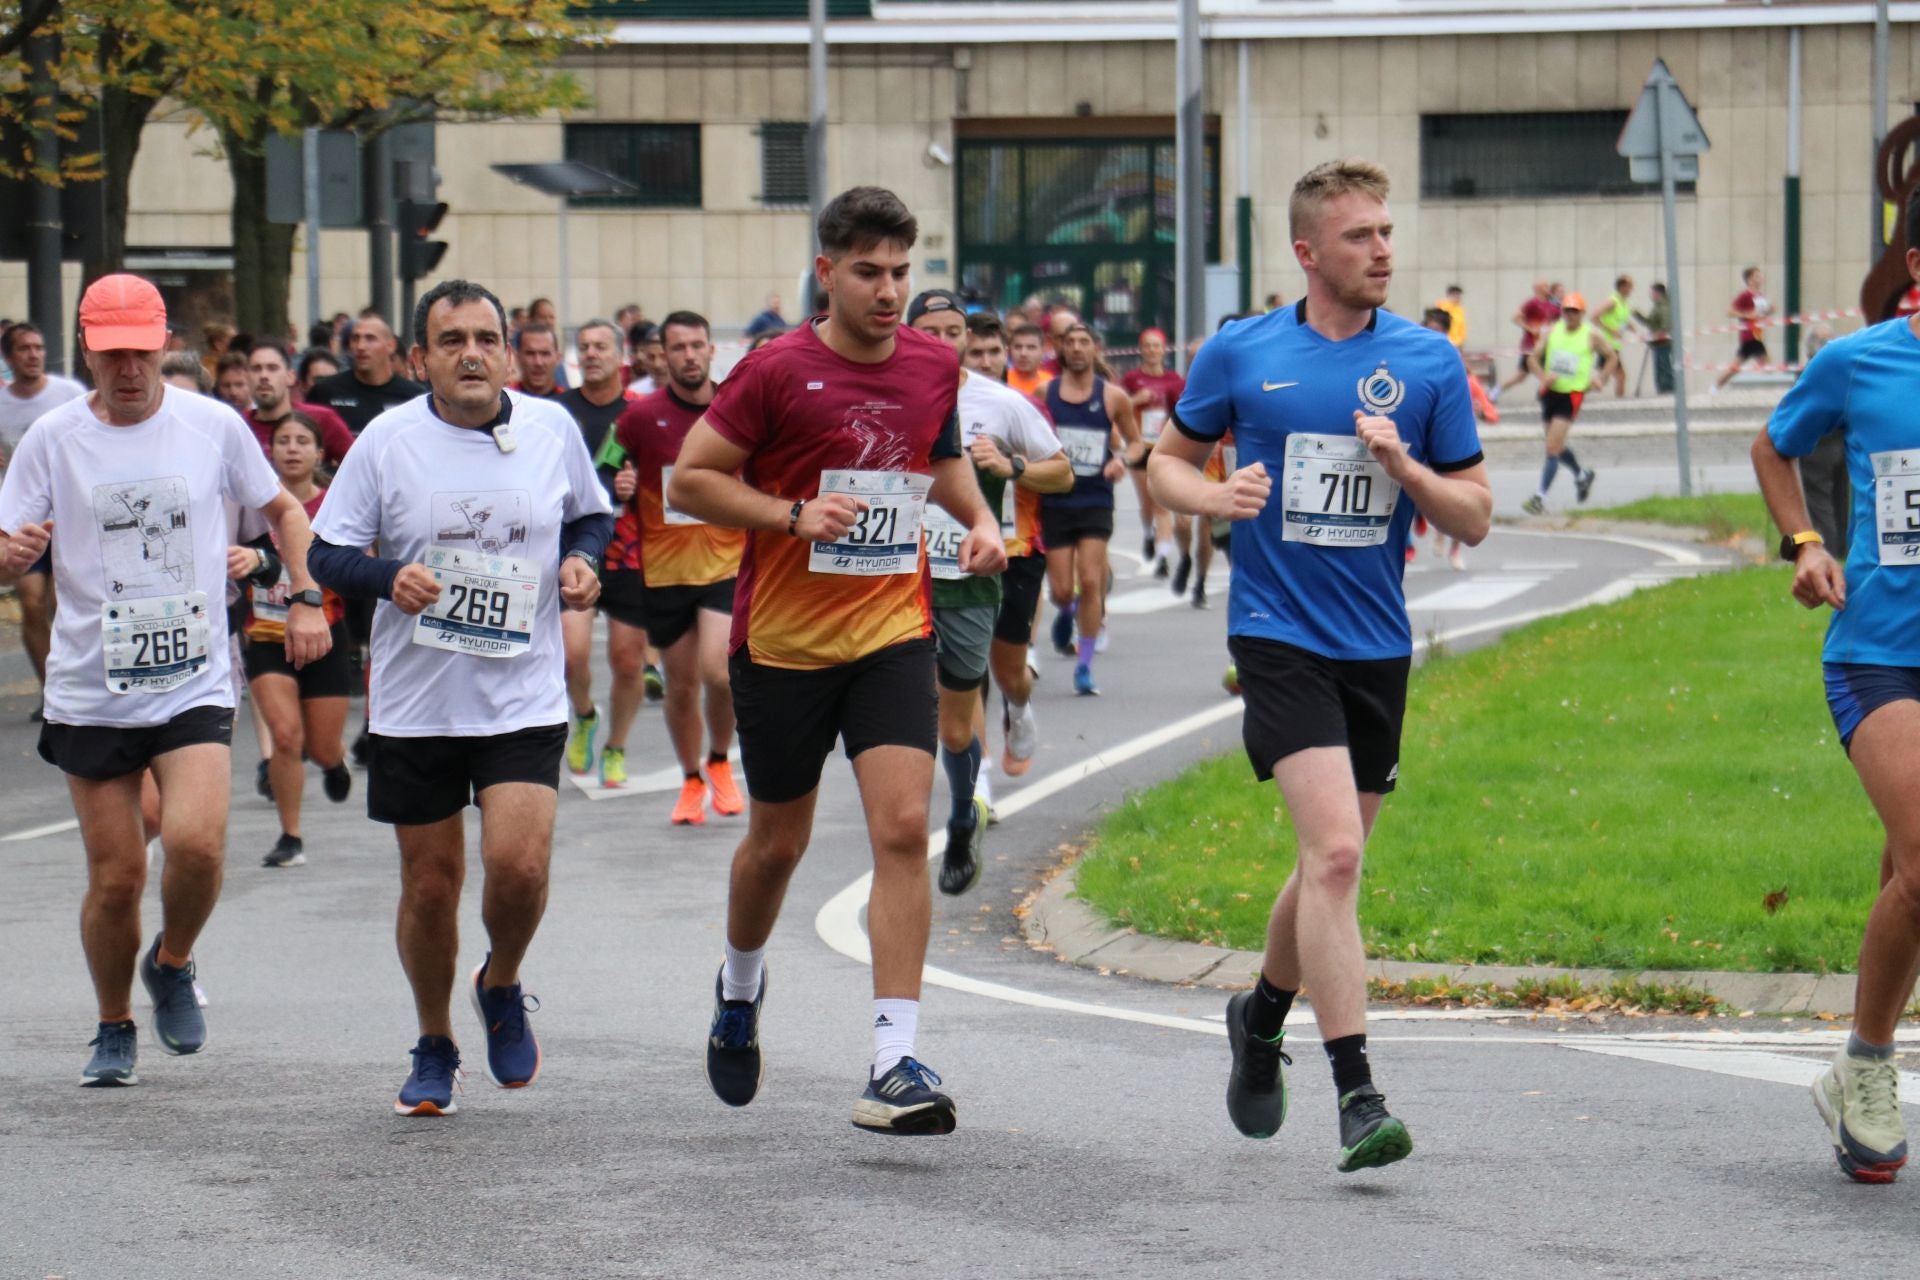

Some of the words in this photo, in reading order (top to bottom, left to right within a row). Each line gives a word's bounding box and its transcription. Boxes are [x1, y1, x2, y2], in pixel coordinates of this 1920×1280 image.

[1332, 462, 1365, 472] KILIAN
[869, 496, 884, 506] GIL
[1320, 473, 1372, 514] 710
[1905, 490, 1920, 530] 5
[848, 508, 898, 545] 321
[1328, 528, 1378, 539] HYUNDAI
[923, 529, 962, 558] 245
[855, 557, 901, 568] HYUNDAI
[464, 576, 500, 590] ENRIQUE
[446, 584, 510, 628] 269
[131, 627, 188, 666] 266
[459, 636, 511, 652] HYUNDAI
[150, 670, 194, 686] HYUNDAI
